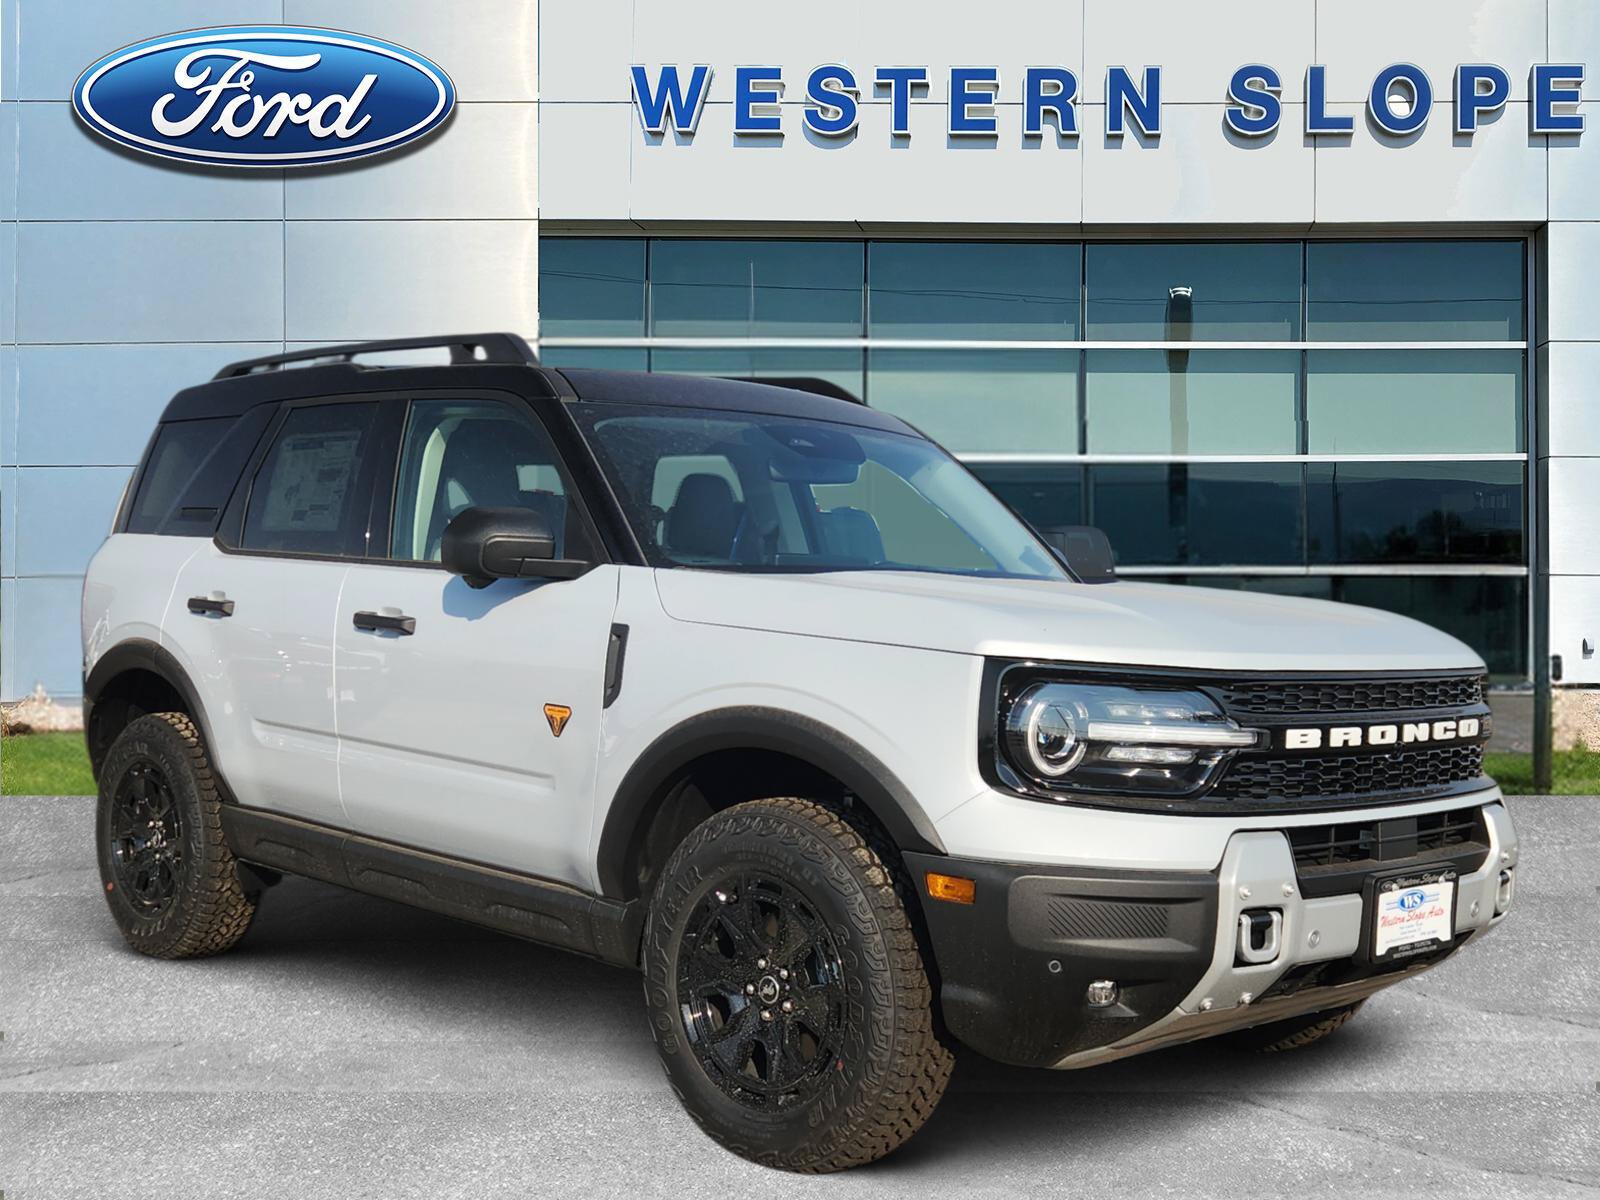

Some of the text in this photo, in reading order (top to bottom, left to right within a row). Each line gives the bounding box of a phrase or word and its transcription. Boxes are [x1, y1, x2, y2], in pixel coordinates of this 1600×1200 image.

[151, 48, 378, 139] Ford
[629, 63, 1587, 137] WESTERN SLOPE
[1285, 718, 1480, 749] BRONCO
[1402, 893, 1424, 909] WS
